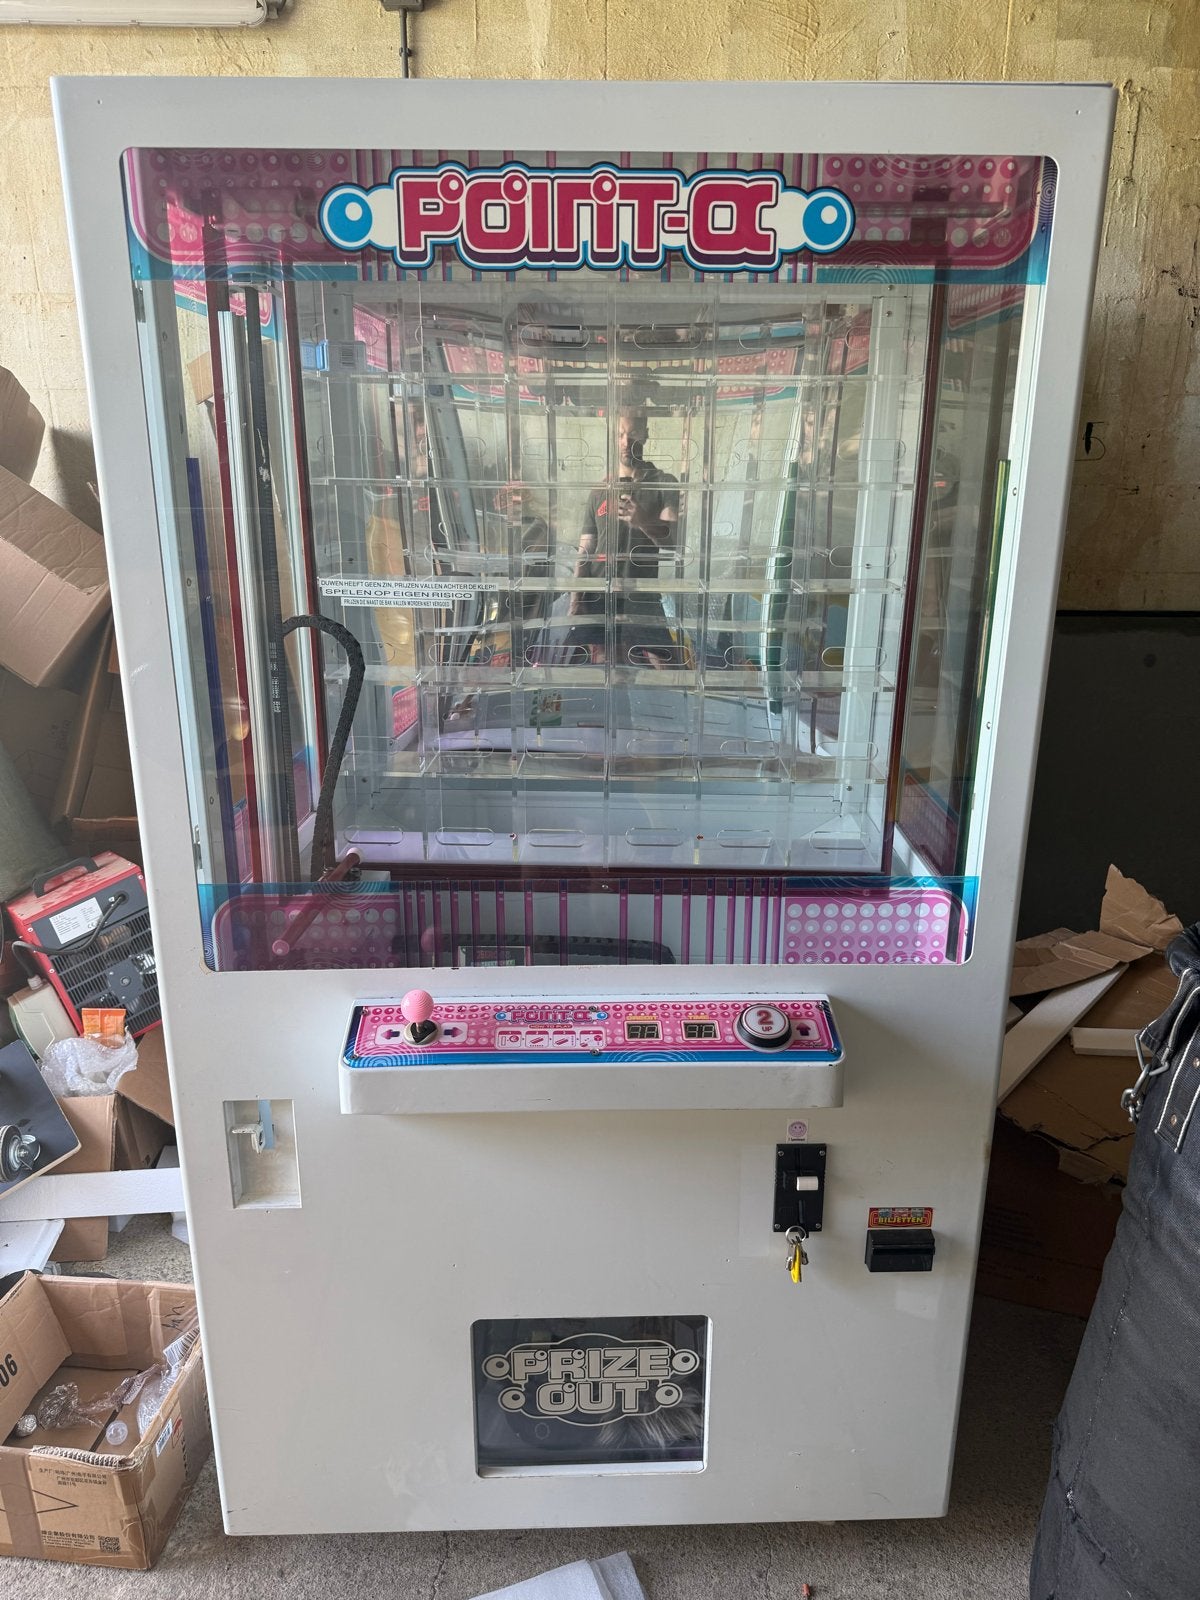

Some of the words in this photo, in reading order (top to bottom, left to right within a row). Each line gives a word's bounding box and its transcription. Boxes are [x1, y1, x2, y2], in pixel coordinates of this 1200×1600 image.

[325, 588, 372, 596] SPELEN
[420, 582, 442, 590] VALLEN
[757, 1009, 774, 1026] 2
[878, 1216, 923, 1224] BILJETTEN
[511, 1347, 671, 1382] PRIZE
[536, 1380, 649, 1415] OUT
